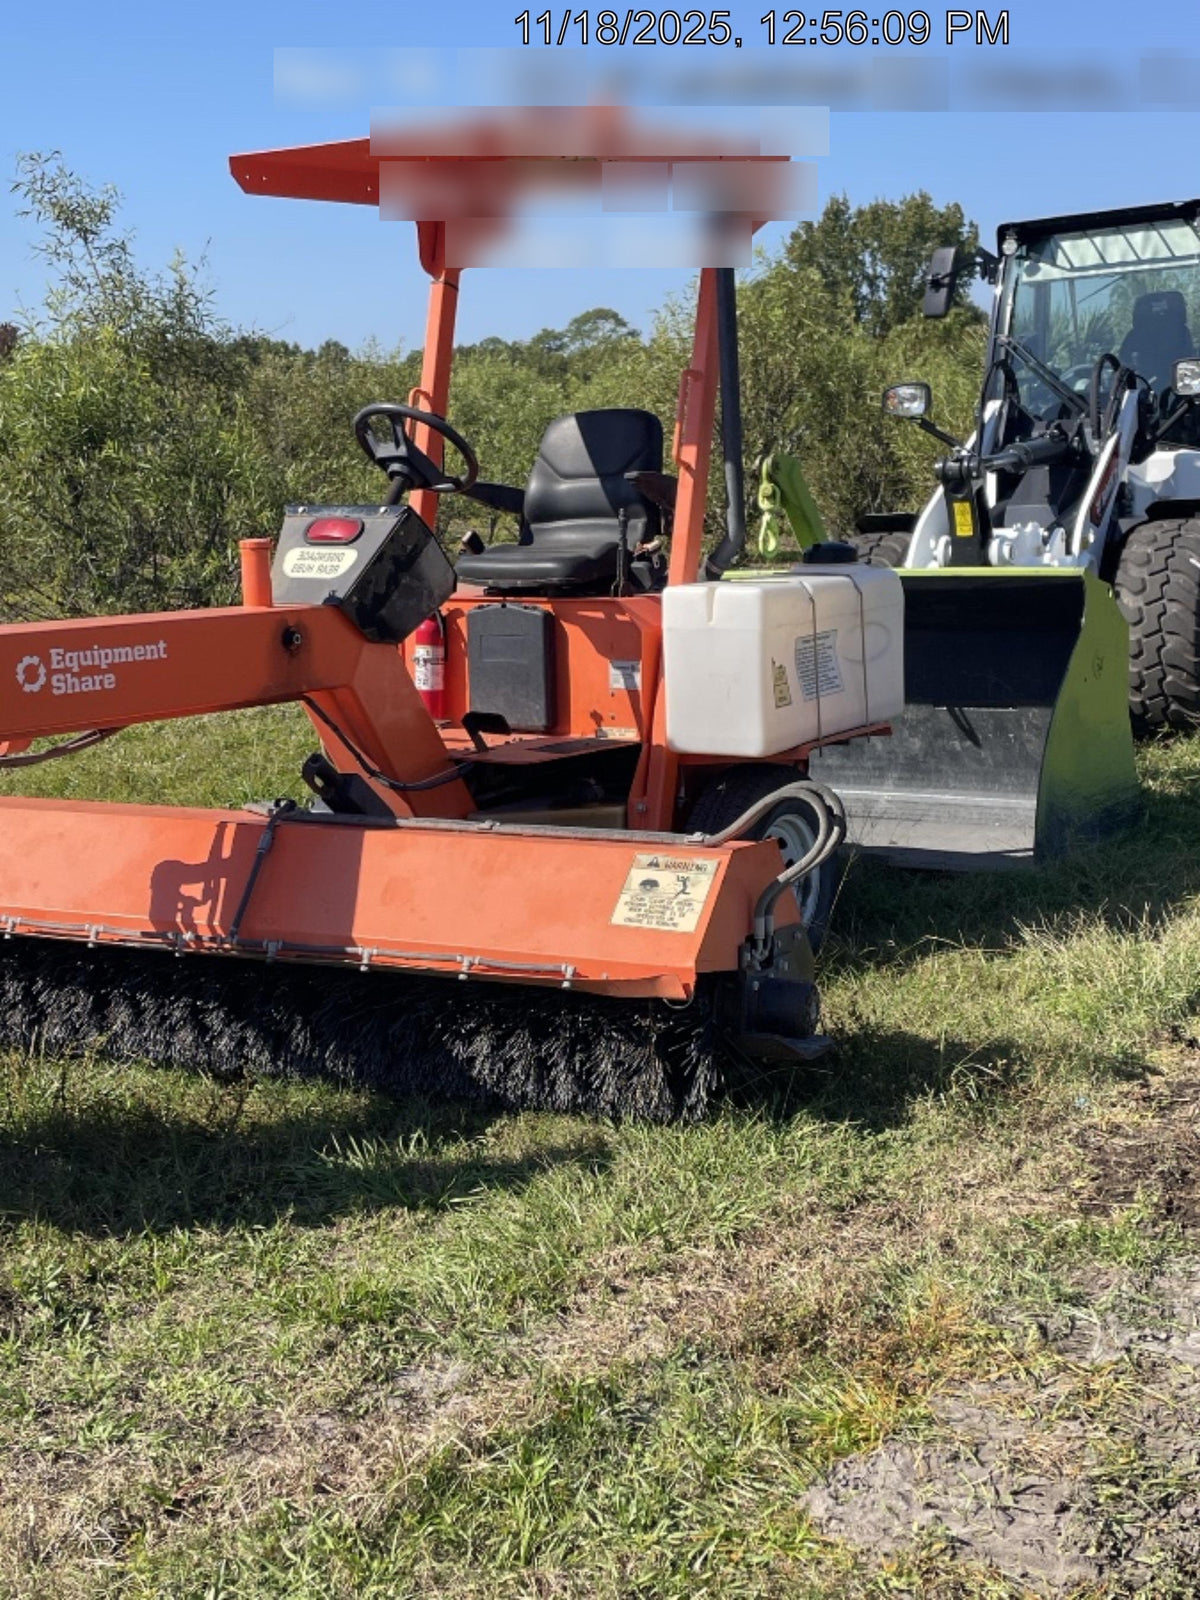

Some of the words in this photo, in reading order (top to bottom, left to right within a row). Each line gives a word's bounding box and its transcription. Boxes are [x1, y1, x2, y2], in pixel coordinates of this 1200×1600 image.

[49, 639, 168, 672] Equipment
[50, 672, 116, 696] Share
[664, 859, 708, 873] WARNING
